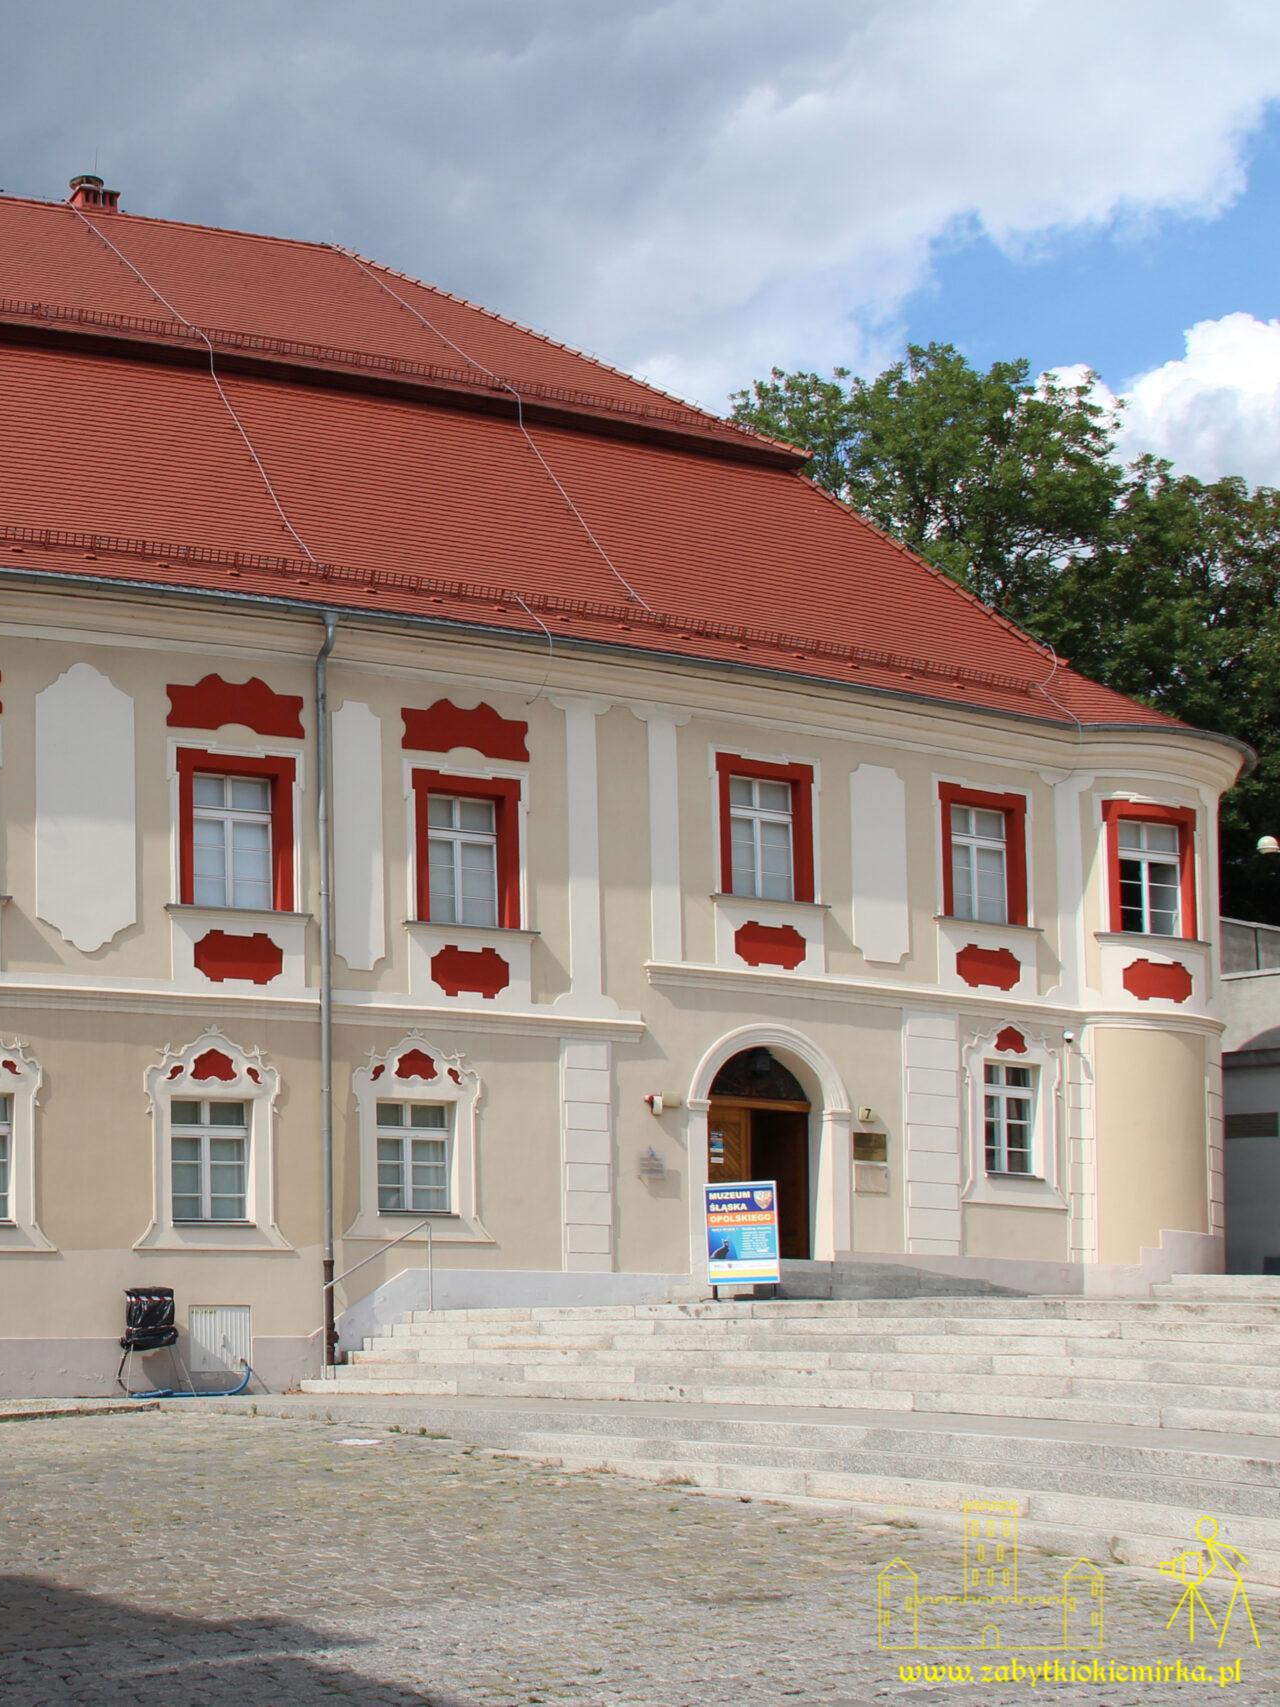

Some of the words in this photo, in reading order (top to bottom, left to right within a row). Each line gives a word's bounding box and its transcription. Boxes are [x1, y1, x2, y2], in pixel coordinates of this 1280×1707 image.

[865, 1108, 871, 1119] 7
[709, 1191, 751, 1200] MUZEUM
[710, 1203, 748, 1213] ŚLĄSKA
[710, 1214, 771, 1223] OPOLSKIEGO
